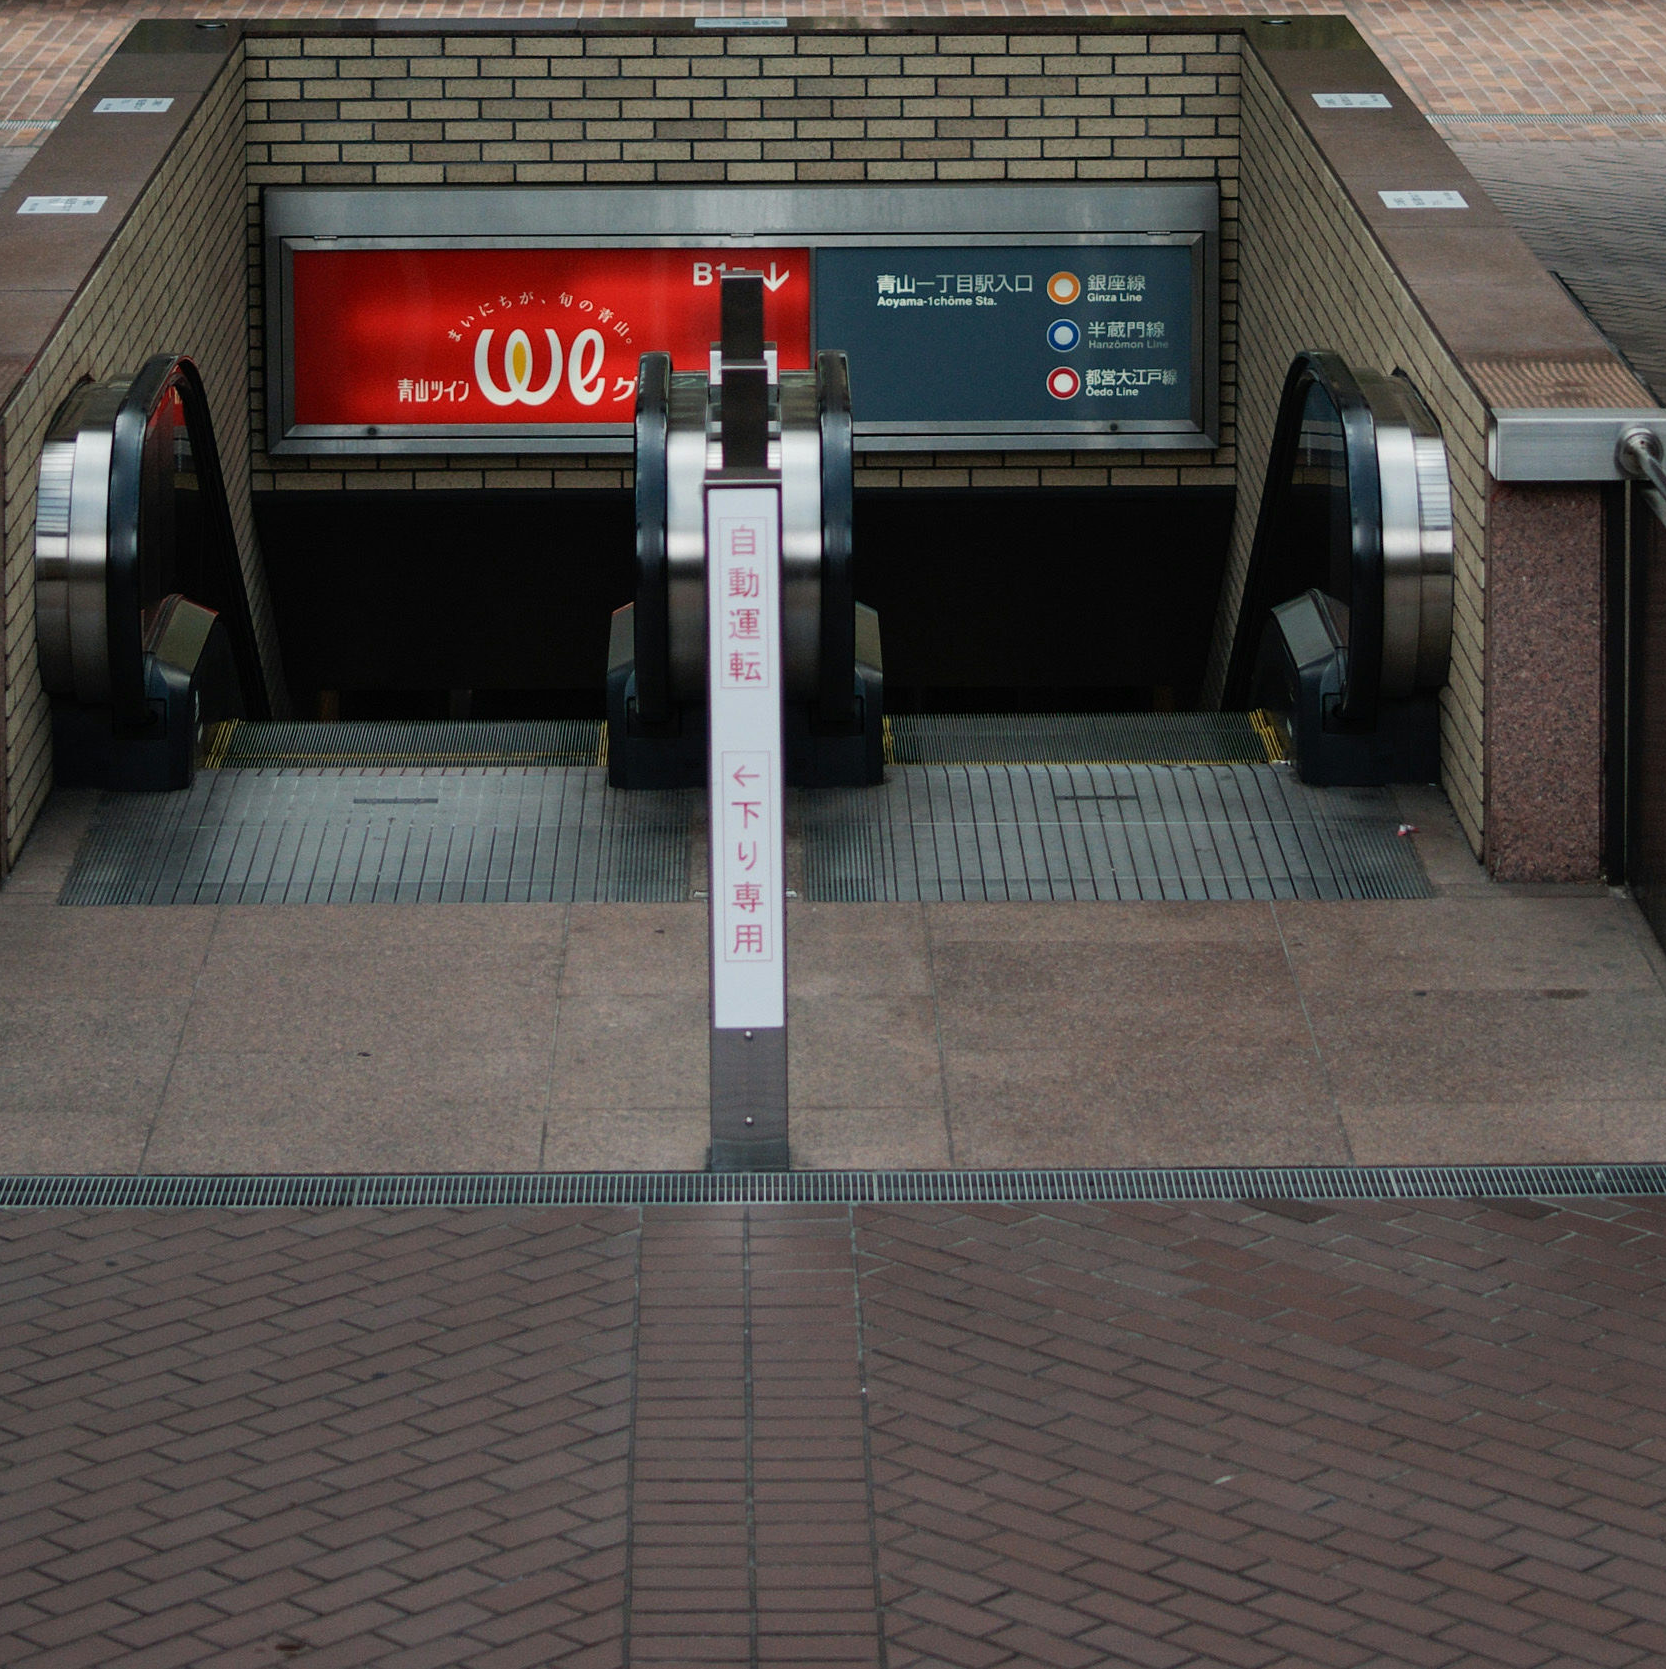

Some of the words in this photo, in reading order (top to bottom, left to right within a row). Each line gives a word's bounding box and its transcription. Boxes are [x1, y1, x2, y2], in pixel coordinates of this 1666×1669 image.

[876, 273, 1033, 294] 青山一丁目駅入口
[1087, 274, 1146, 292] 銀座線
[975, 295, 998, 307] Sta.
[1087, 292, 1117, 302] Ginza
[1119, 292, 1143, 302] Line
[1087, 320, 1165, 338] 半蔵門線
[1146, 339, 1170, 349] Line
[1085, 368, 1178, 386] 都営大江戸線
[397, 378, 470, 403] 青山ツイン
[1116, 387, 1139, 397] Line
[727, 524, 761, 682] 自動運転
[731, 801, 764, 954] 下り専用
